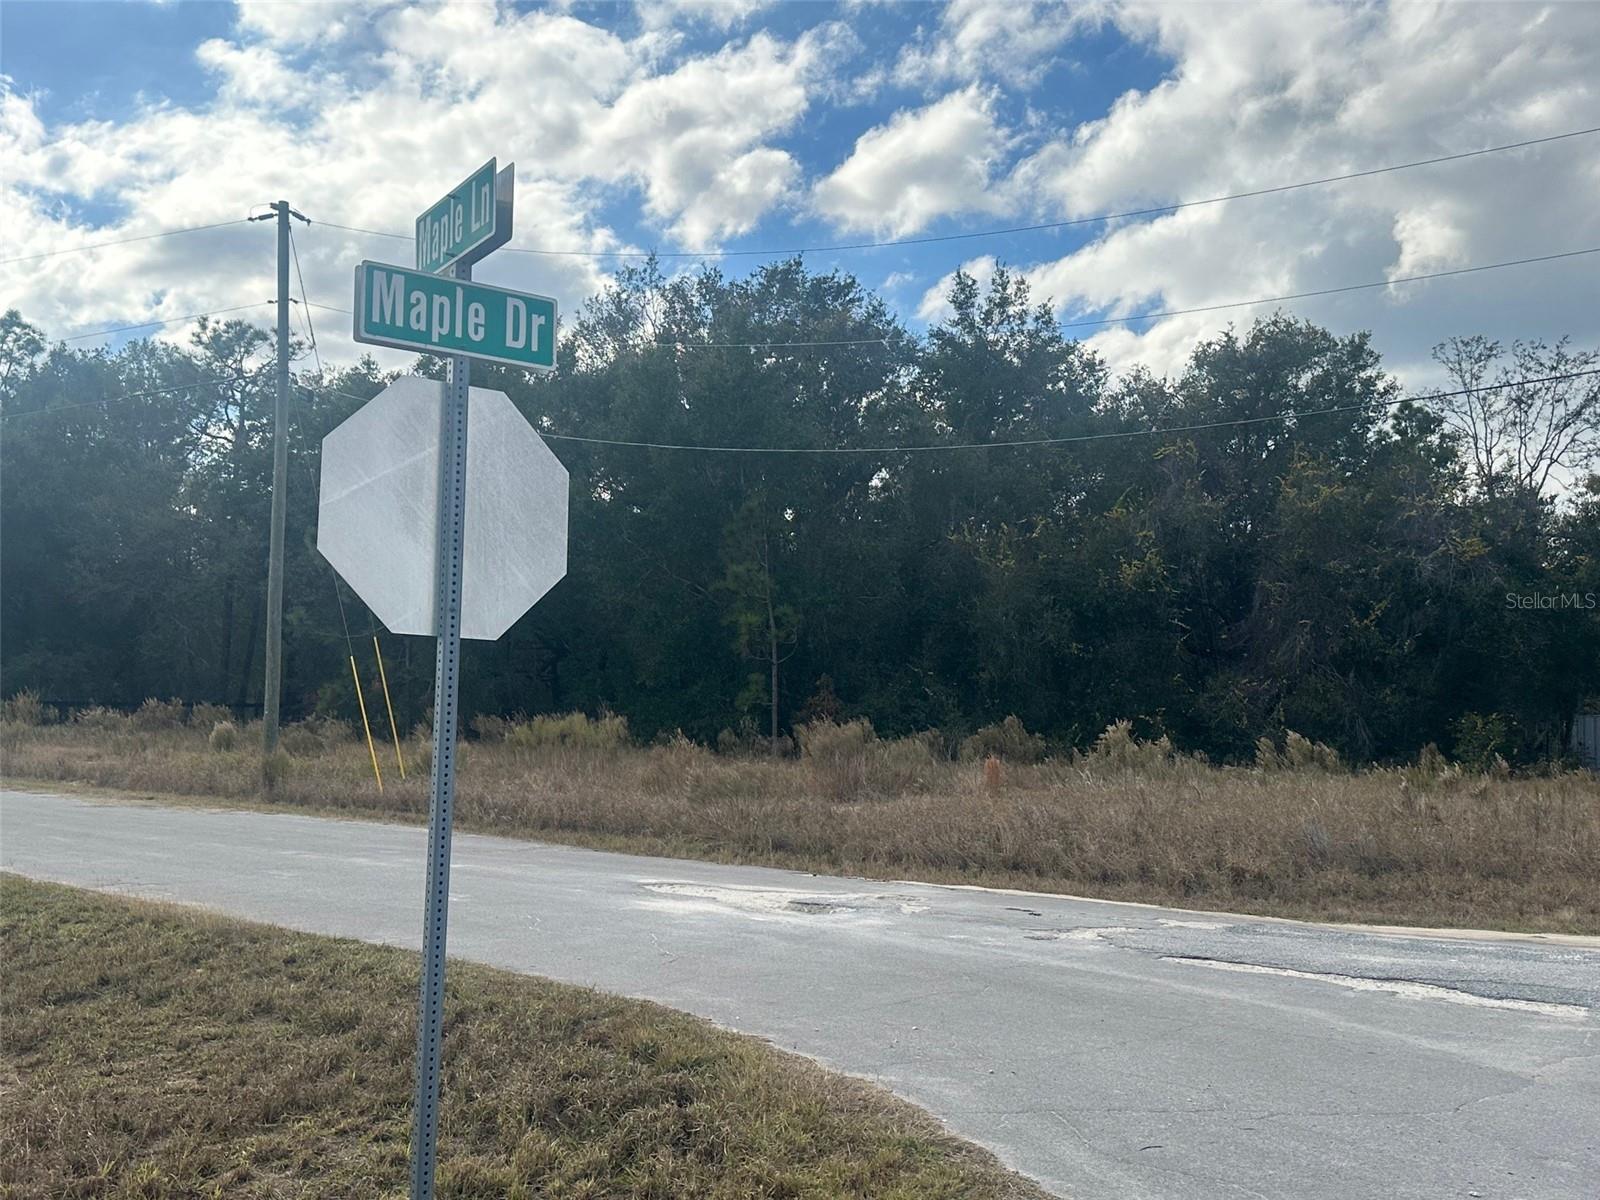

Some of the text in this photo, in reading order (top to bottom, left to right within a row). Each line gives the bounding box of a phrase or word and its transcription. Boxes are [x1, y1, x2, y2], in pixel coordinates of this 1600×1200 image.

[418, 180, 490, 268] Maple Ln
[371, 269, 546, 352] Maple Dr
